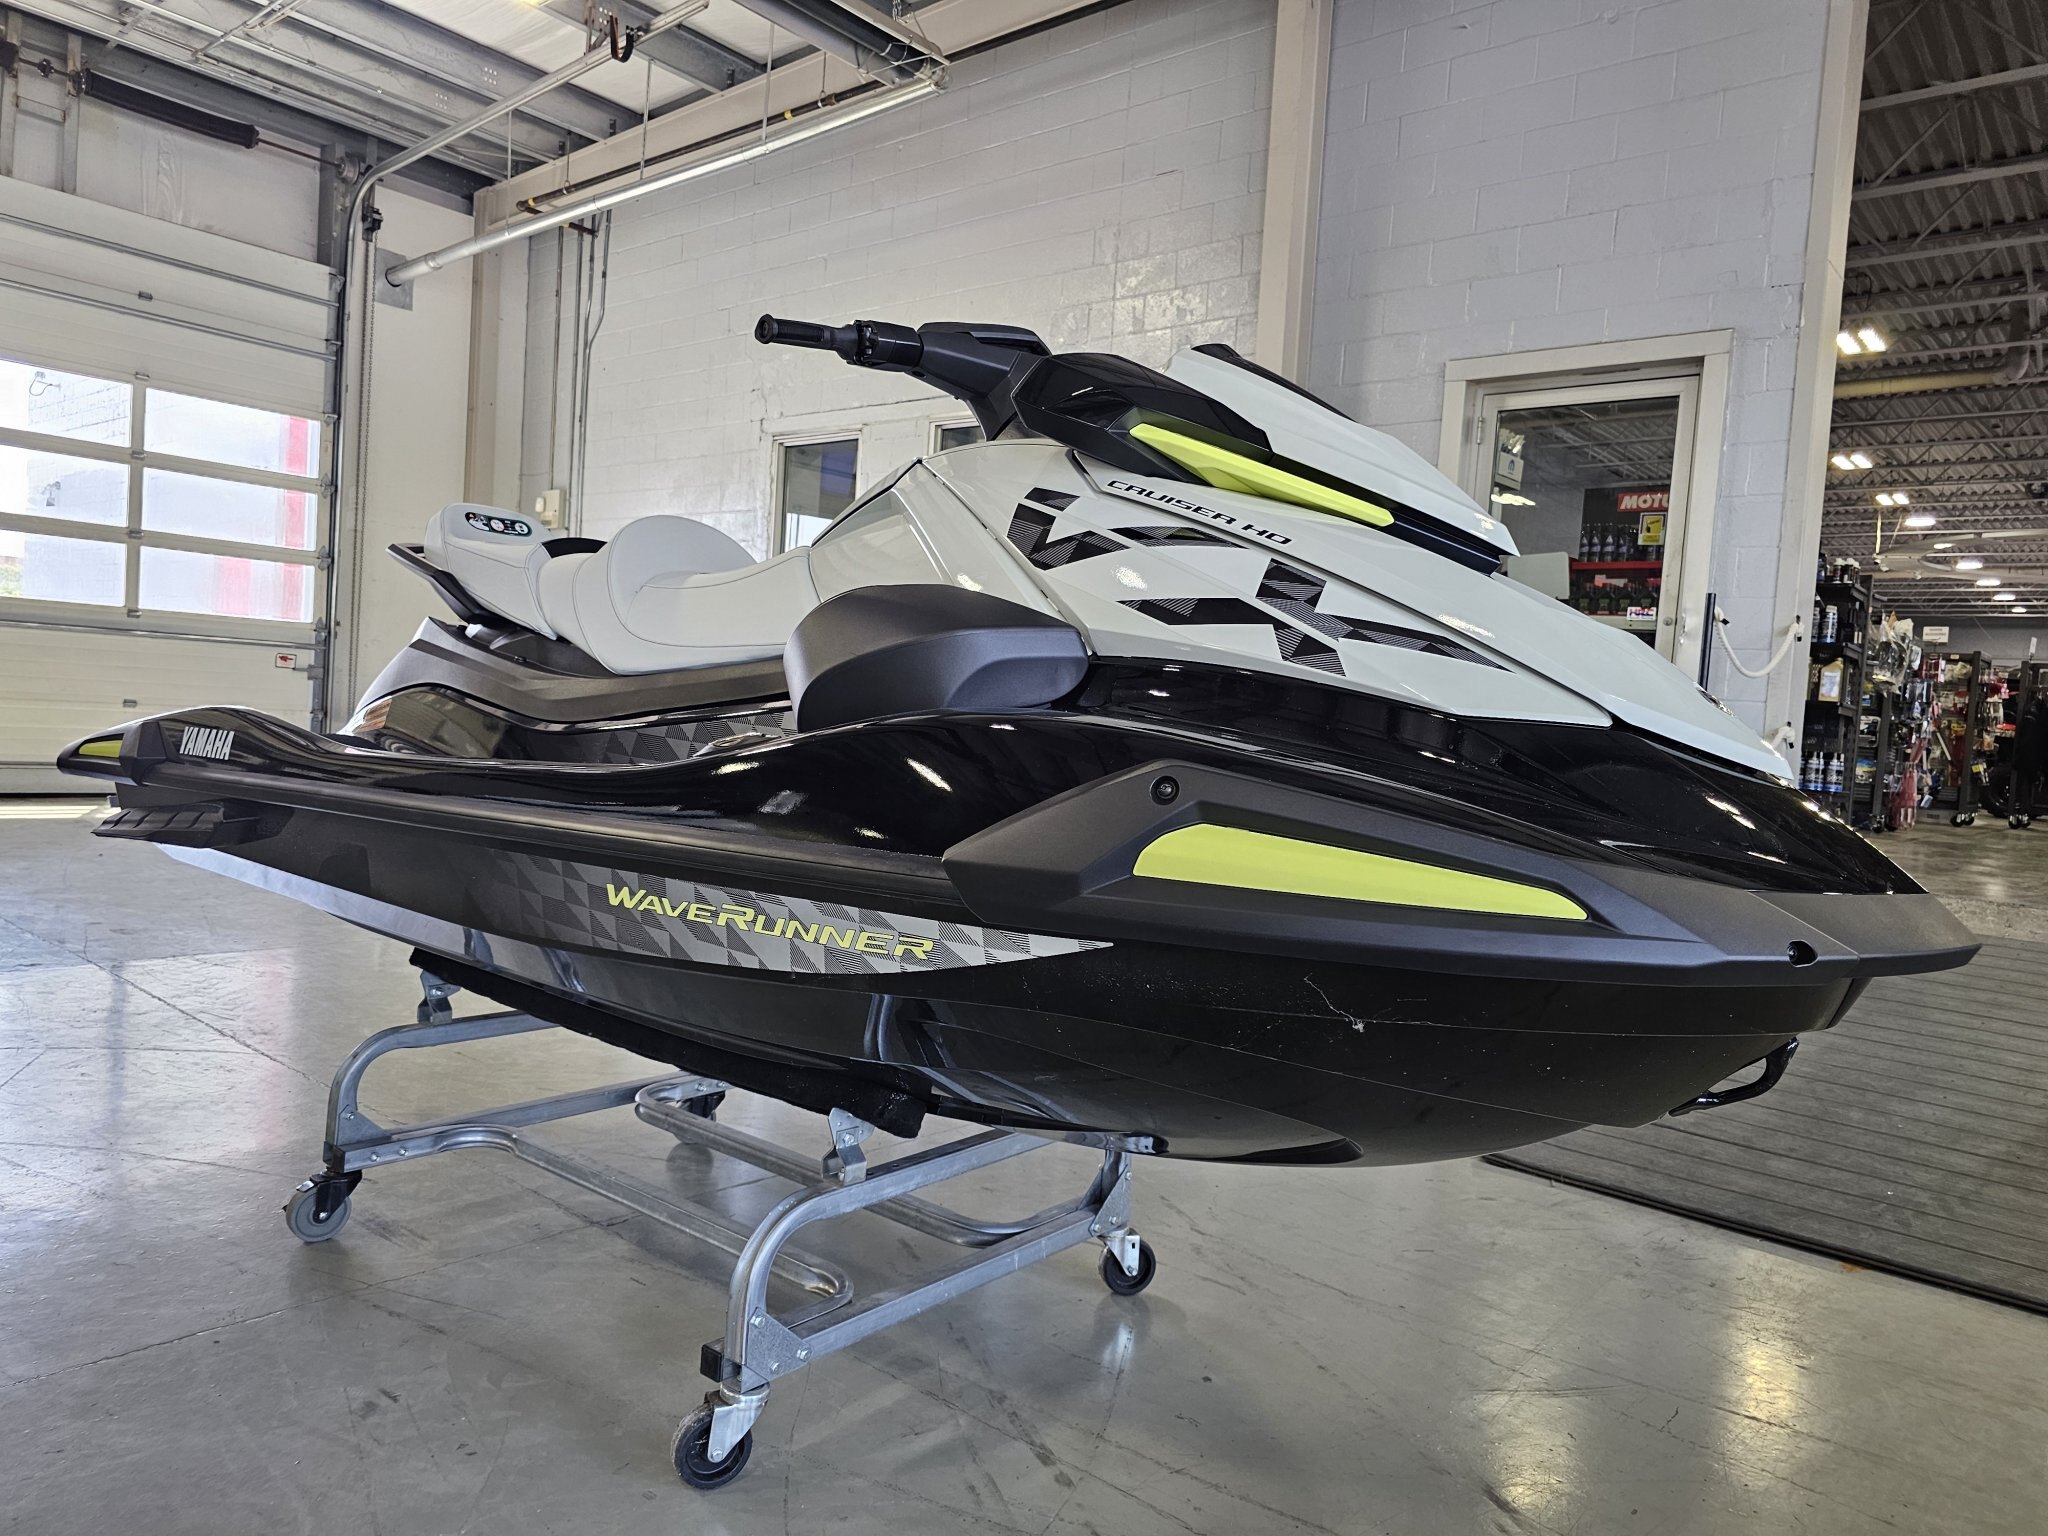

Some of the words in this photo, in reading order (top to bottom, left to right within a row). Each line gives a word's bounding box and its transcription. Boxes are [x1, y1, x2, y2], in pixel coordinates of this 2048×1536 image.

[1107, 480, 1237, 525] CRUISER
[1241, 524, 1292, 545] HO
[179, 726, 235, 760] YAMAHA
[606, 883, 934, 961] WAVERUNNER
